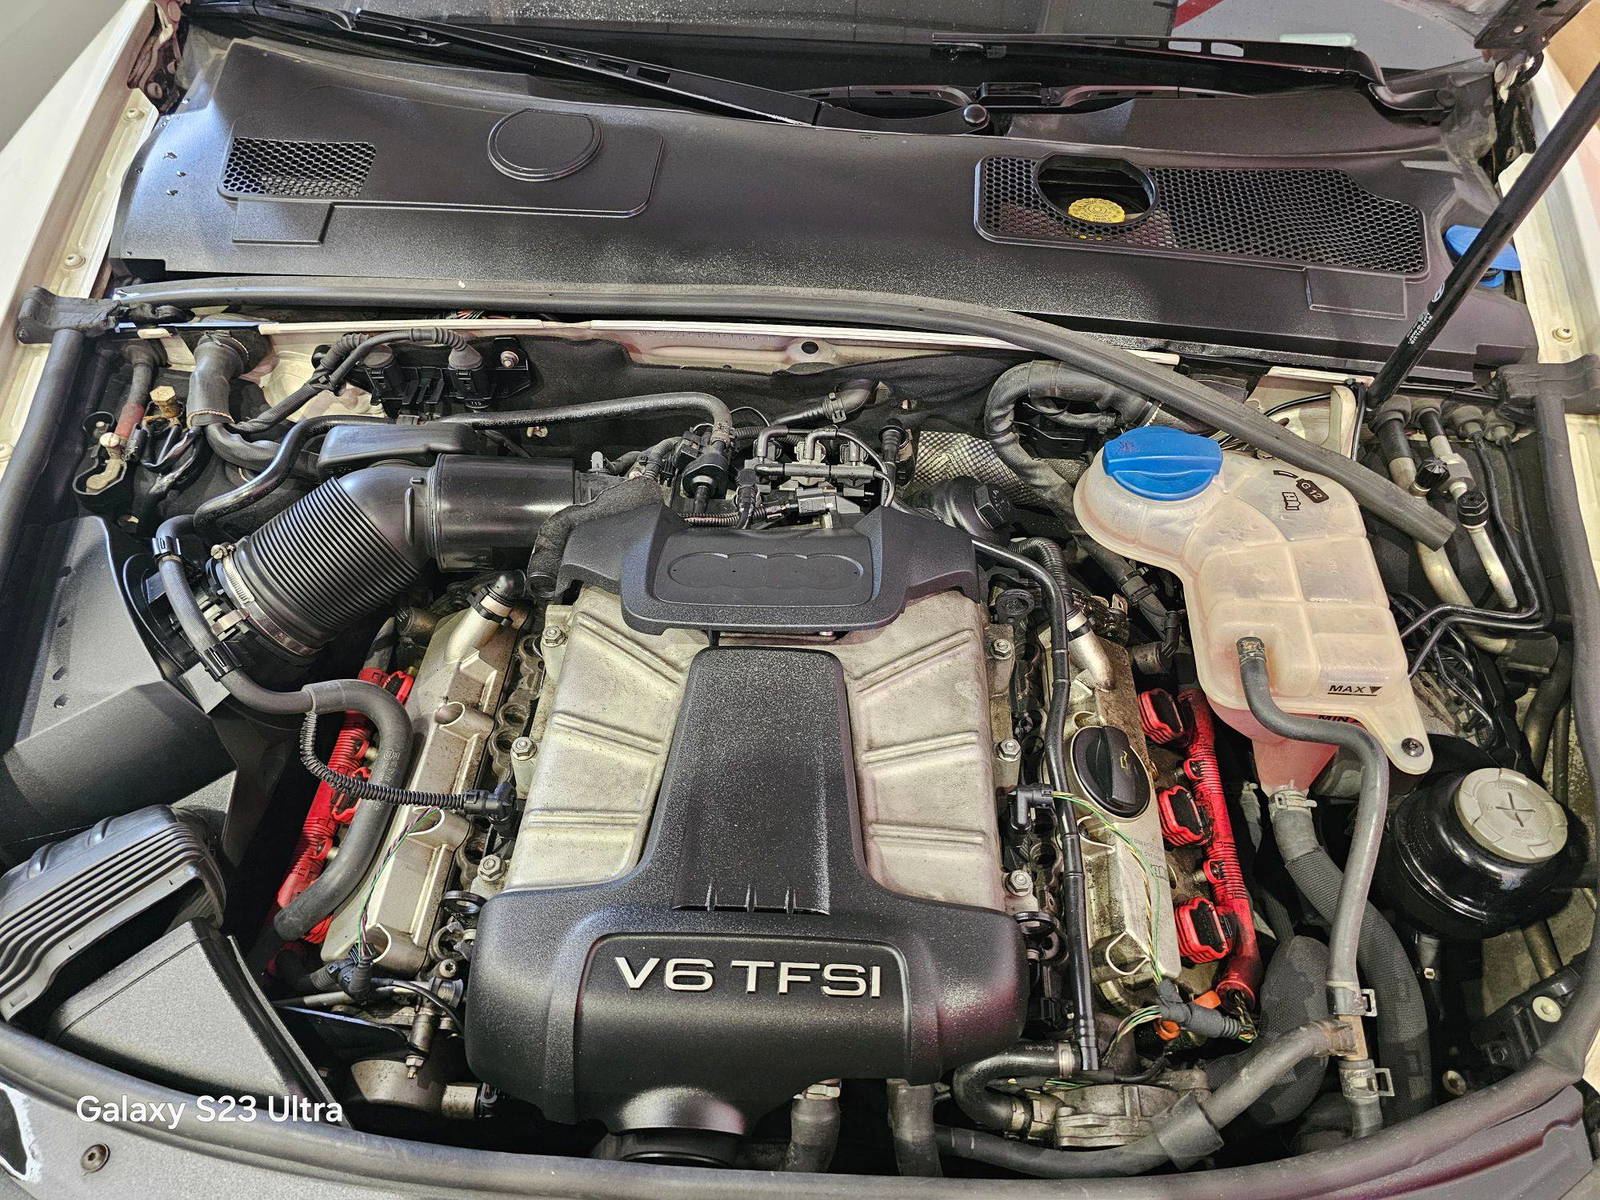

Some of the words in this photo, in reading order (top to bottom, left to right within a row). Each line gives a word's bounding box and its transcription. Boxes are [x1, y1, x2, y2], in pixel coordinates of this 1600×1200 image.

[1329, 685, 1366, 693] MAX
[614, 956, 715, 992] V6
[730, 960, 881, 998] TFSI
